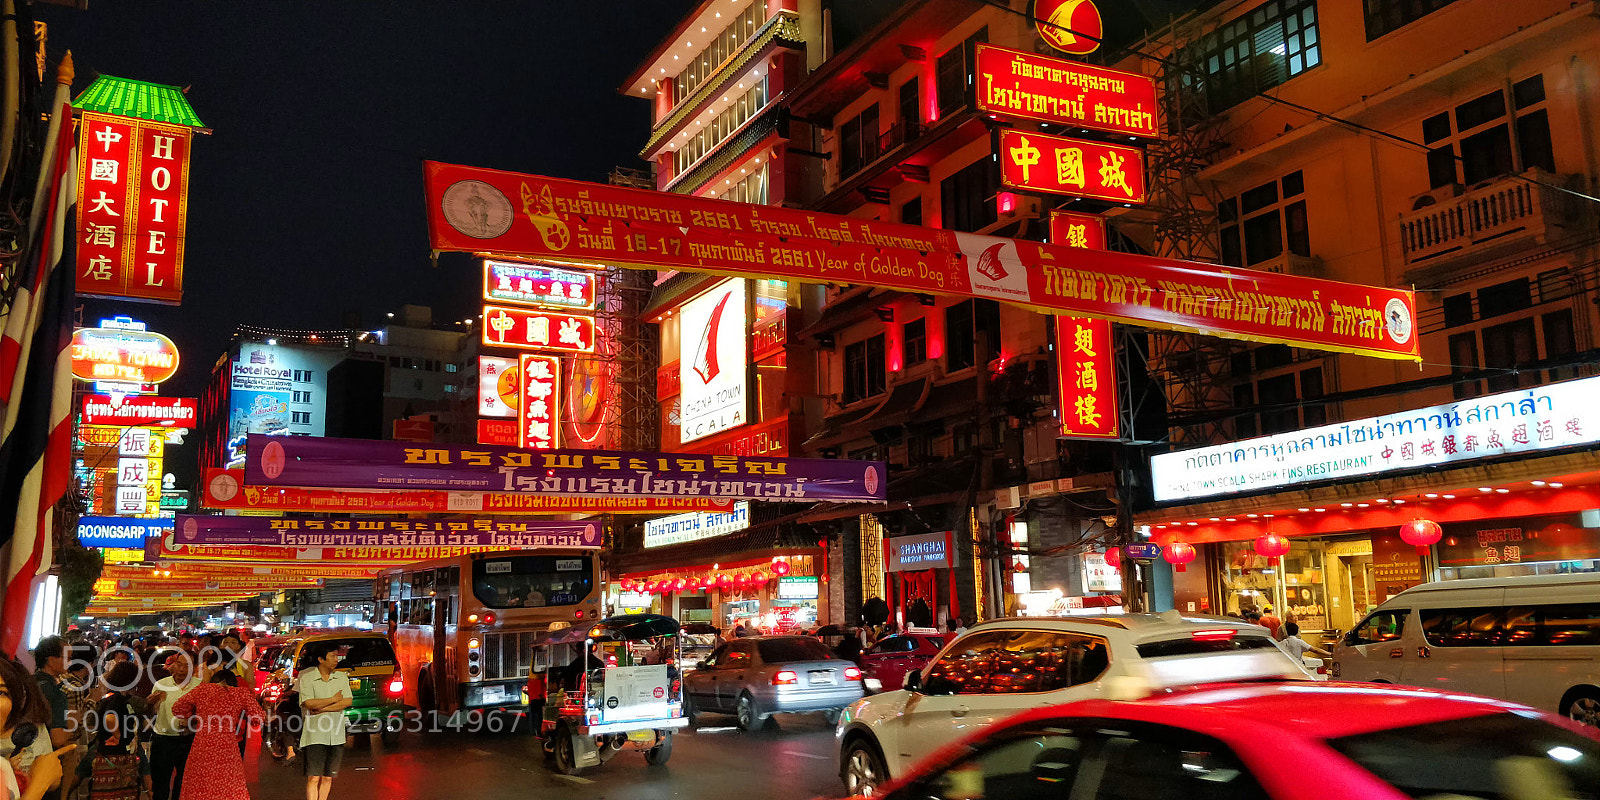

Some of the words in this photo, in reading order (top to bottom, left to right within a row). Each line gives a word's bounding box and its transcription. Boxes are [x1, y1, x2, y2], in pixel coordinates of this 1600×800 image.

[983, 73, 1085, 120] ไชน่าทาวน์
[1094, 103, 1153, 131] สกาล่า
[1010, 136, 1133, 197] 中國城
[83, 126, 123, 281] 中國大酒店
[145, 135, 175, 287] HOTEL
[690, 209, 741, 231] 2561
[578, 220, 616, 250] วันที่
[688, 240, 766, 267] กุมภาพันธ์
[771, 247, 813, 268] 2561
[816, 250, 849, 273] Year
[853, 254, 867, 279] of
[870, 257, 915, 278] Golden
[918, 262, 944, 288] Dog
[235, 365, 262, 375] Hotel
[264, 367, 292, 378] Royal
[685, 396, 712, 416] CHINA
[716, 384, 741, 404] TOWN
[685, 410, 741, 440] SCALA
[1217, 475, 1246, 487] SCALA
[1249, 471, 1279, 483] SHARK
[1282, 467, 1303, 480] FINS
[1306, 455, 1374, 476] RESTAURANT
[369, 496, 385, 507] Year
[387, 496, 394, 508] of
[395, 497, 419, 508] Golden
[421, 499, 434, 509] Dog
[78, 524, 145, 539] ROONGSARP
[647, 513, 701, 537] ไชน่าทาวน์
[900, 540, 945, 555] SHANGHAI
[1151, 546, 1157, 555] 2
